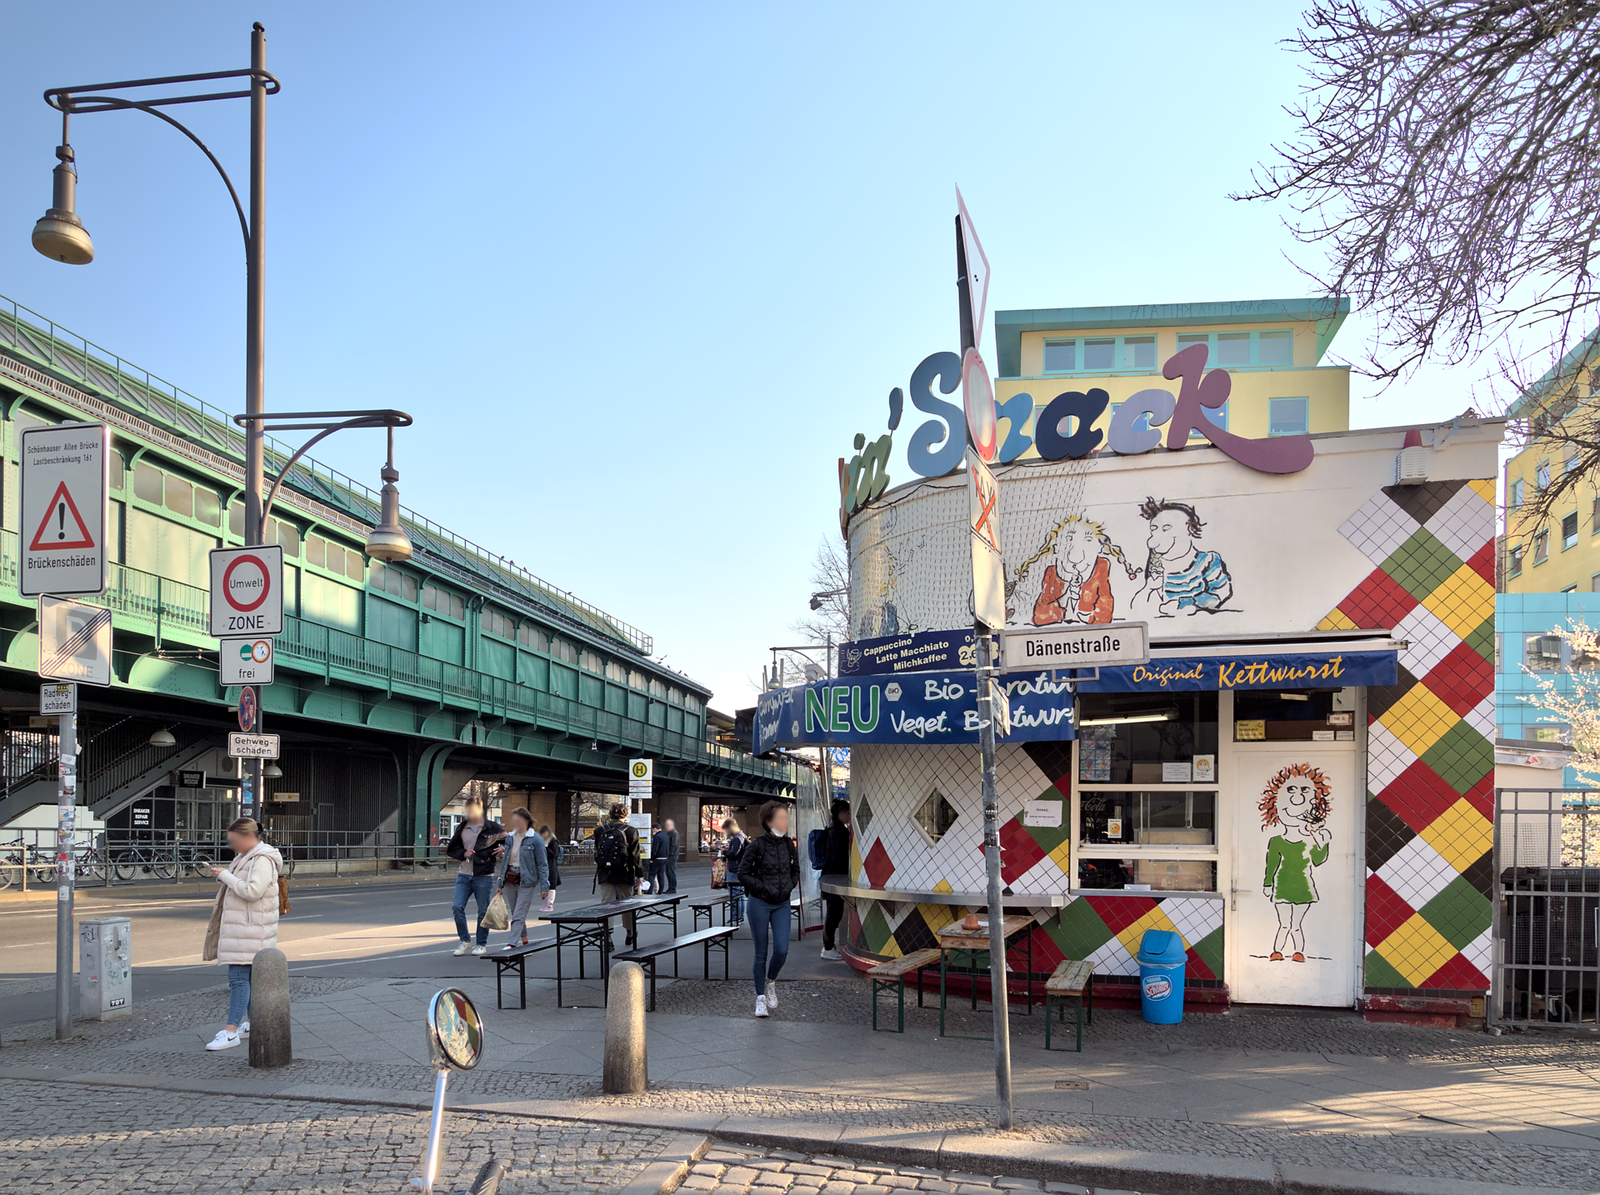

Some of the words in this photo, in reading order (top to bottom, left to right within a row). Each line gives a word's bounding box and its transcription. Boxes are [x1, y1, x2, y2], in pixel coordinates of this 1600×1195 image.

[907, 342, 1315, 478] Snack
[27, 443, 61, 455] Schönhauser
[63, 442, 78, 451] Allee
[79, 440, 99, 451] Brücke
[33, 454, 81, 466] Lastbeschränkung
[27, 554, 96, 570] Brückenschäden
[229, 577, 264, 590] Umwelt
[228, 614, 265, 631] ZONE
[863, 637, 912, 657] Cappuccino
[875, 650, 898, 664] Latte
[899, 640, 949, 660] Macchiato
[1025, 635, 1121, 658] Dänenstraße
[59, 661, 94, 679] ZONE
[893, 653, 948, 671] Milchkaffee
[238, 667, 256, 679] frei
[1132, 663, 1205, 687] Original
[1218, 655, 1345, 688] Kettwurst
[43, 687, 72, 700] Radweg-
[44, 698, 71, 711] schäden
[805, 685, 880, 734] NEU
[890, 711, 952, 739] Veget.
[234, 736, 274, 747] Gehweg-
[236, 745, 272, 755] schäden
[636, 765, 644, 774] H
